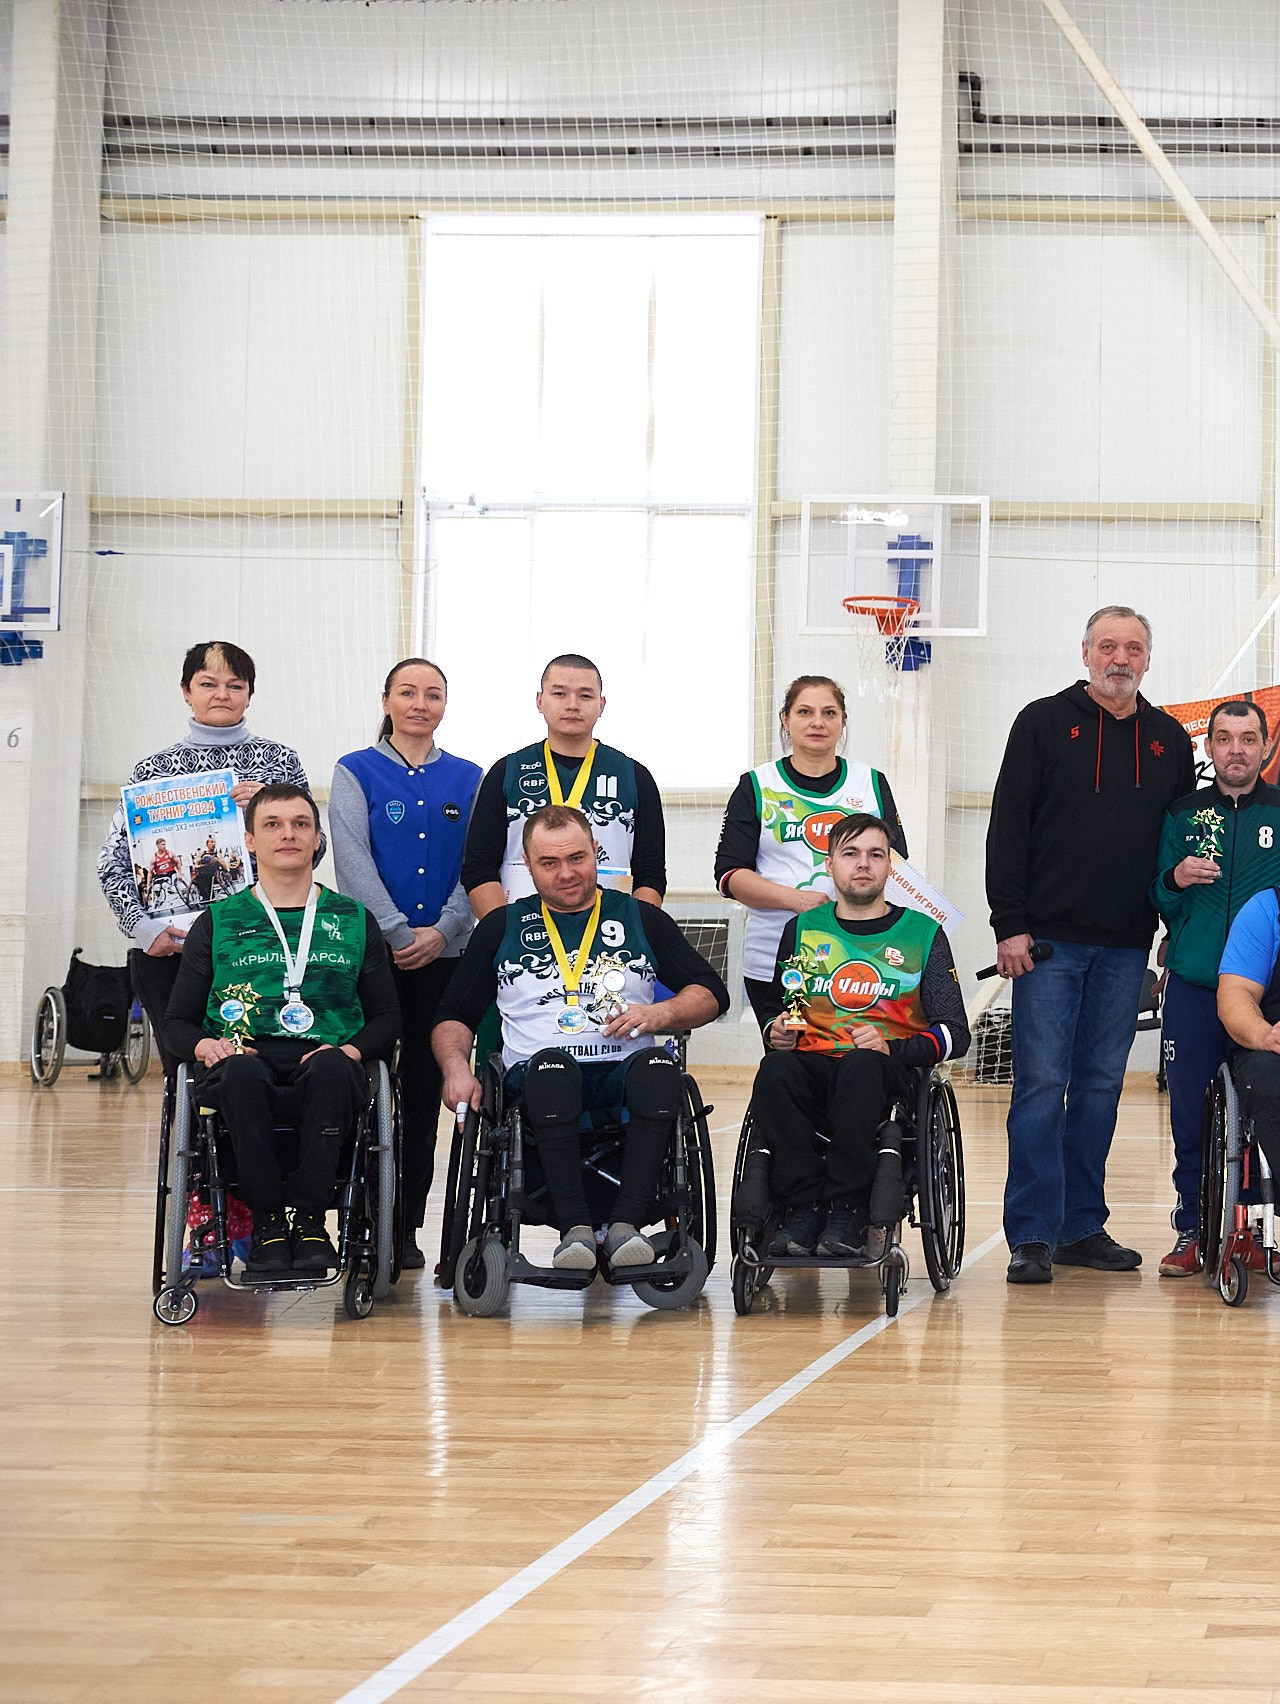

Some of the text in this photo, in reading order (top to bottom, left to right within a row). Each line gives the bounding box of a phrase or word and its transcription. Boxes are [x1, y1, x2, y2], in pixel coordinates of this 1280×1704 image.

[7, 727, 22, 748] 6
[523, 779, 545, 787] RBF
[596, 774, 618, 798] 11
[135, 781, 227, 809] РОЖДЕСТВЕНСКИЙ
[148, 804, 186, 822] ТУРНИР
[188, 800, 215, 816] 2024
[1258, 825, 1274, 849] 8
[889, 867, 948, 923] ЖИВИ ИГРОЙ!
[525, 932, 549, 942] RBF
[601, 919, 626, 947] 9
[1163, 1039, 1175, 1061] 95
